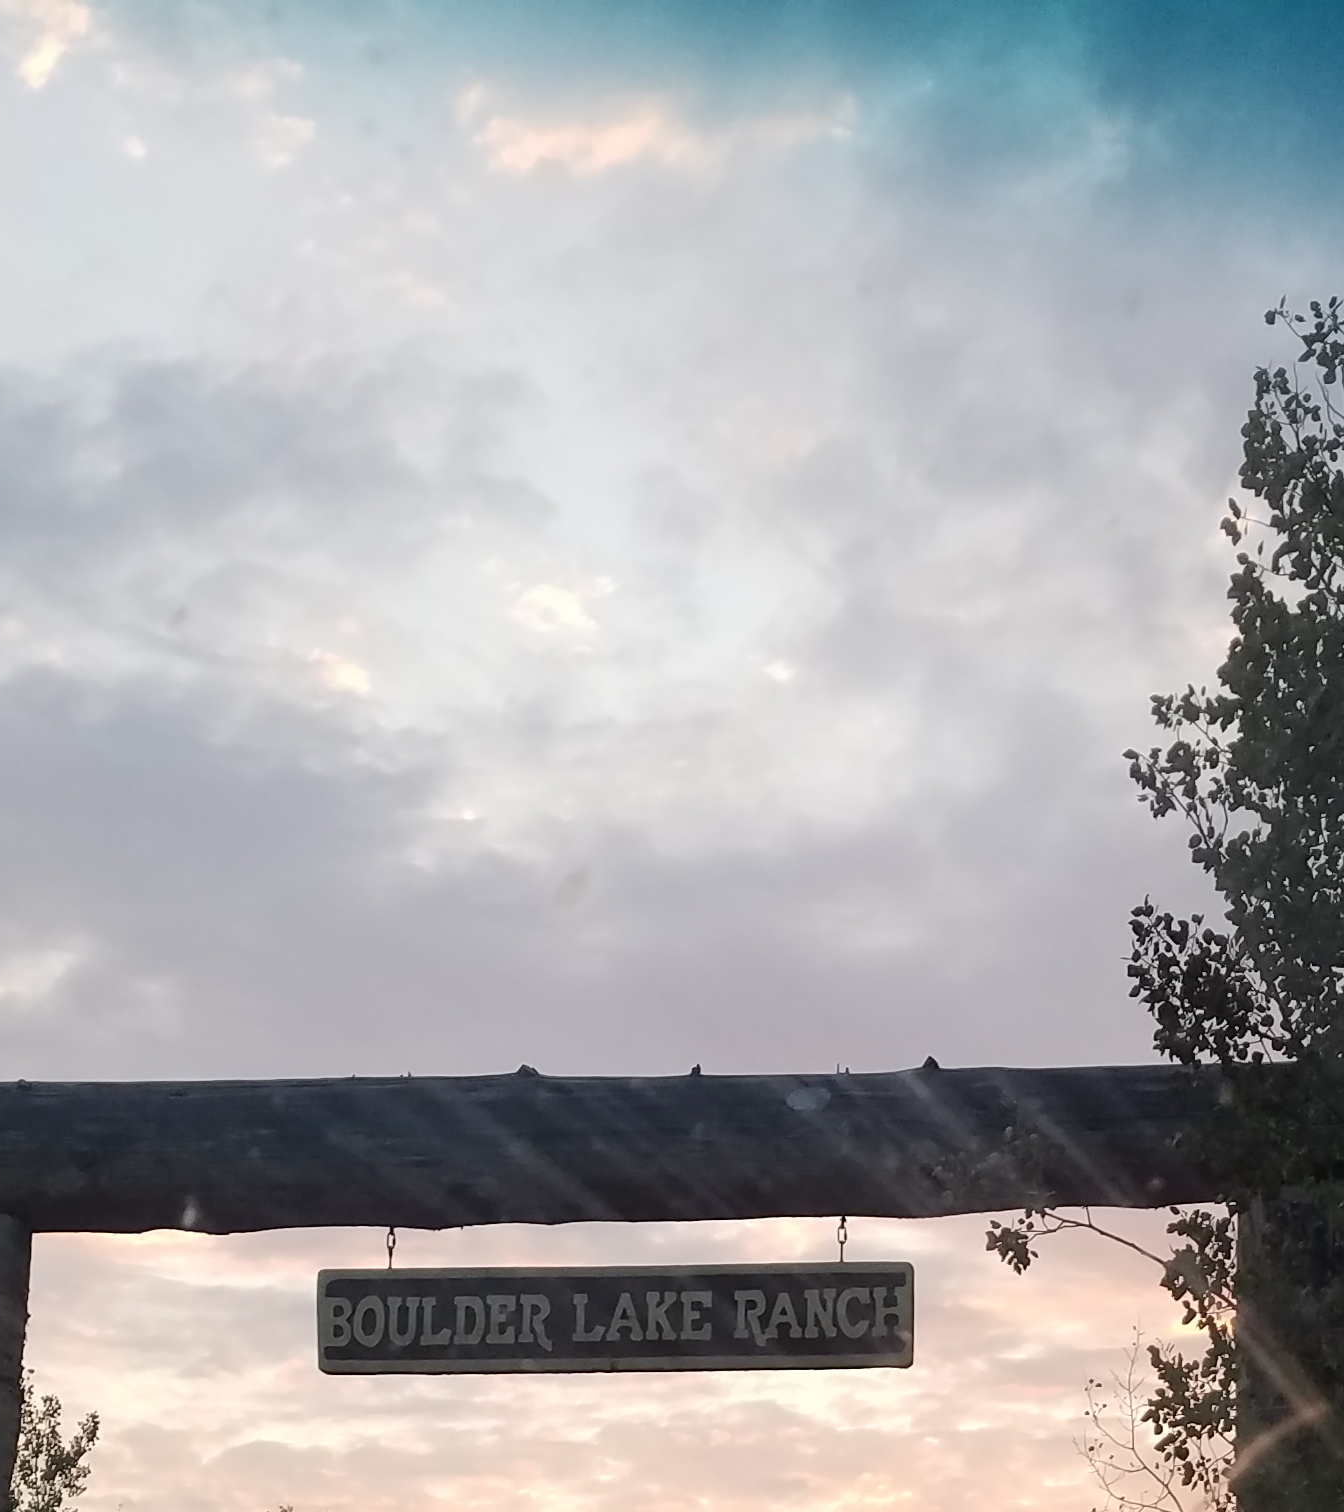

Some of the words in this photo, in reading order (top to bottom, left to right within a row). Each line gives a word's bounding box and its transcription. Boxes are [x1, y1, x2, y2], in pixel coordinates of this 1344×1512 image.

[324, 1293, 553, 1352] BOULDER
[572, 1289, 713, 1343] LAKE
[733, 1285, 907, 1347] RANCH
